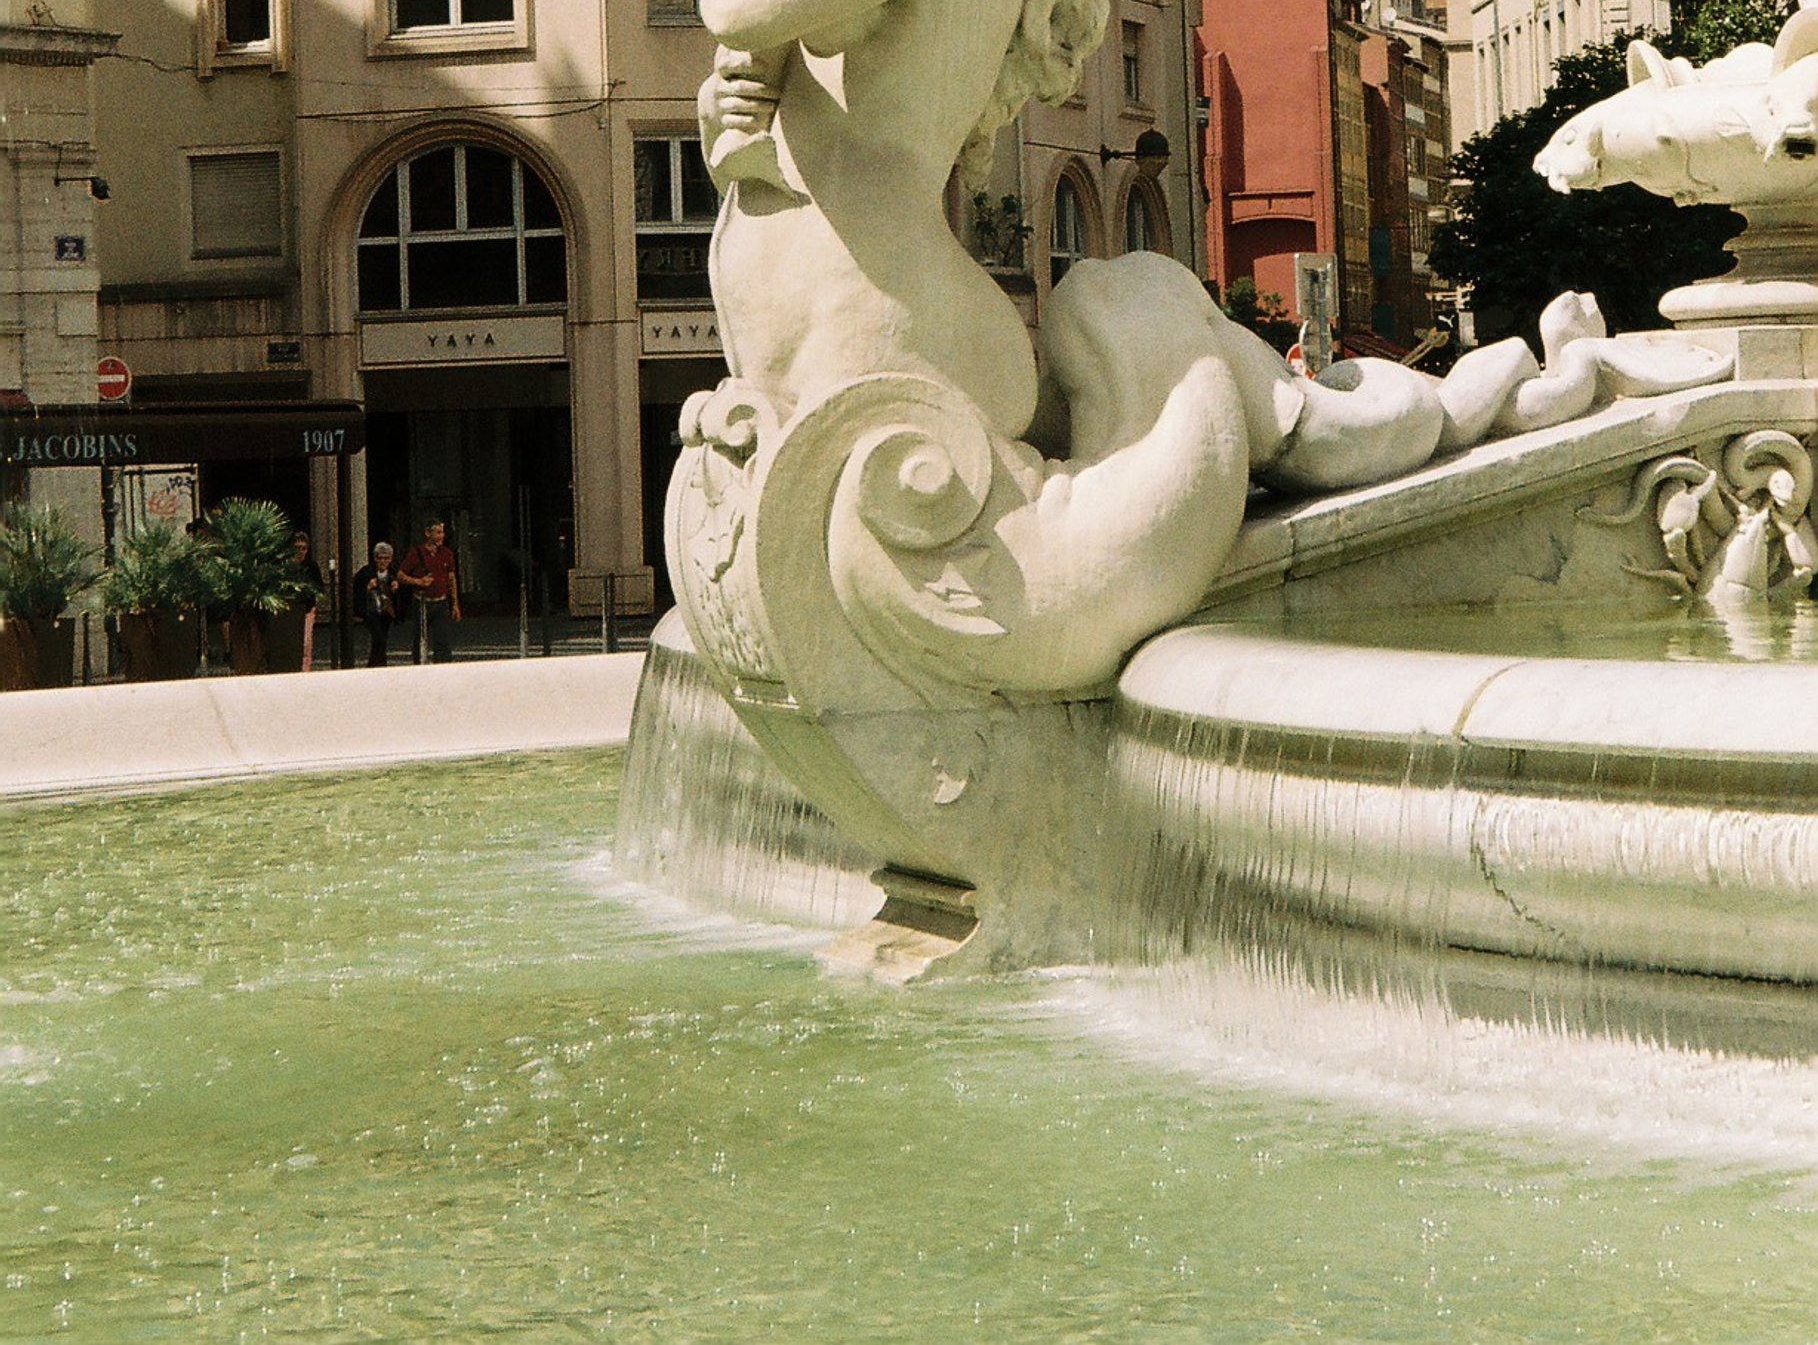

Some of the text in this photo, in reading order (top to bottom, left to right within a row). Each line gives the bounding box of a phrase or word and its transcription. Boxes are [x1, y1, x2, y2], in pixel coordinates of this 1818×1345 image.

[427, 333, 495, 348] YAYA
[652, 324, 718, 339] YAYA
[12, 434, 137, 460] JACOBINS
[303, 429, 345, 453] 1907
